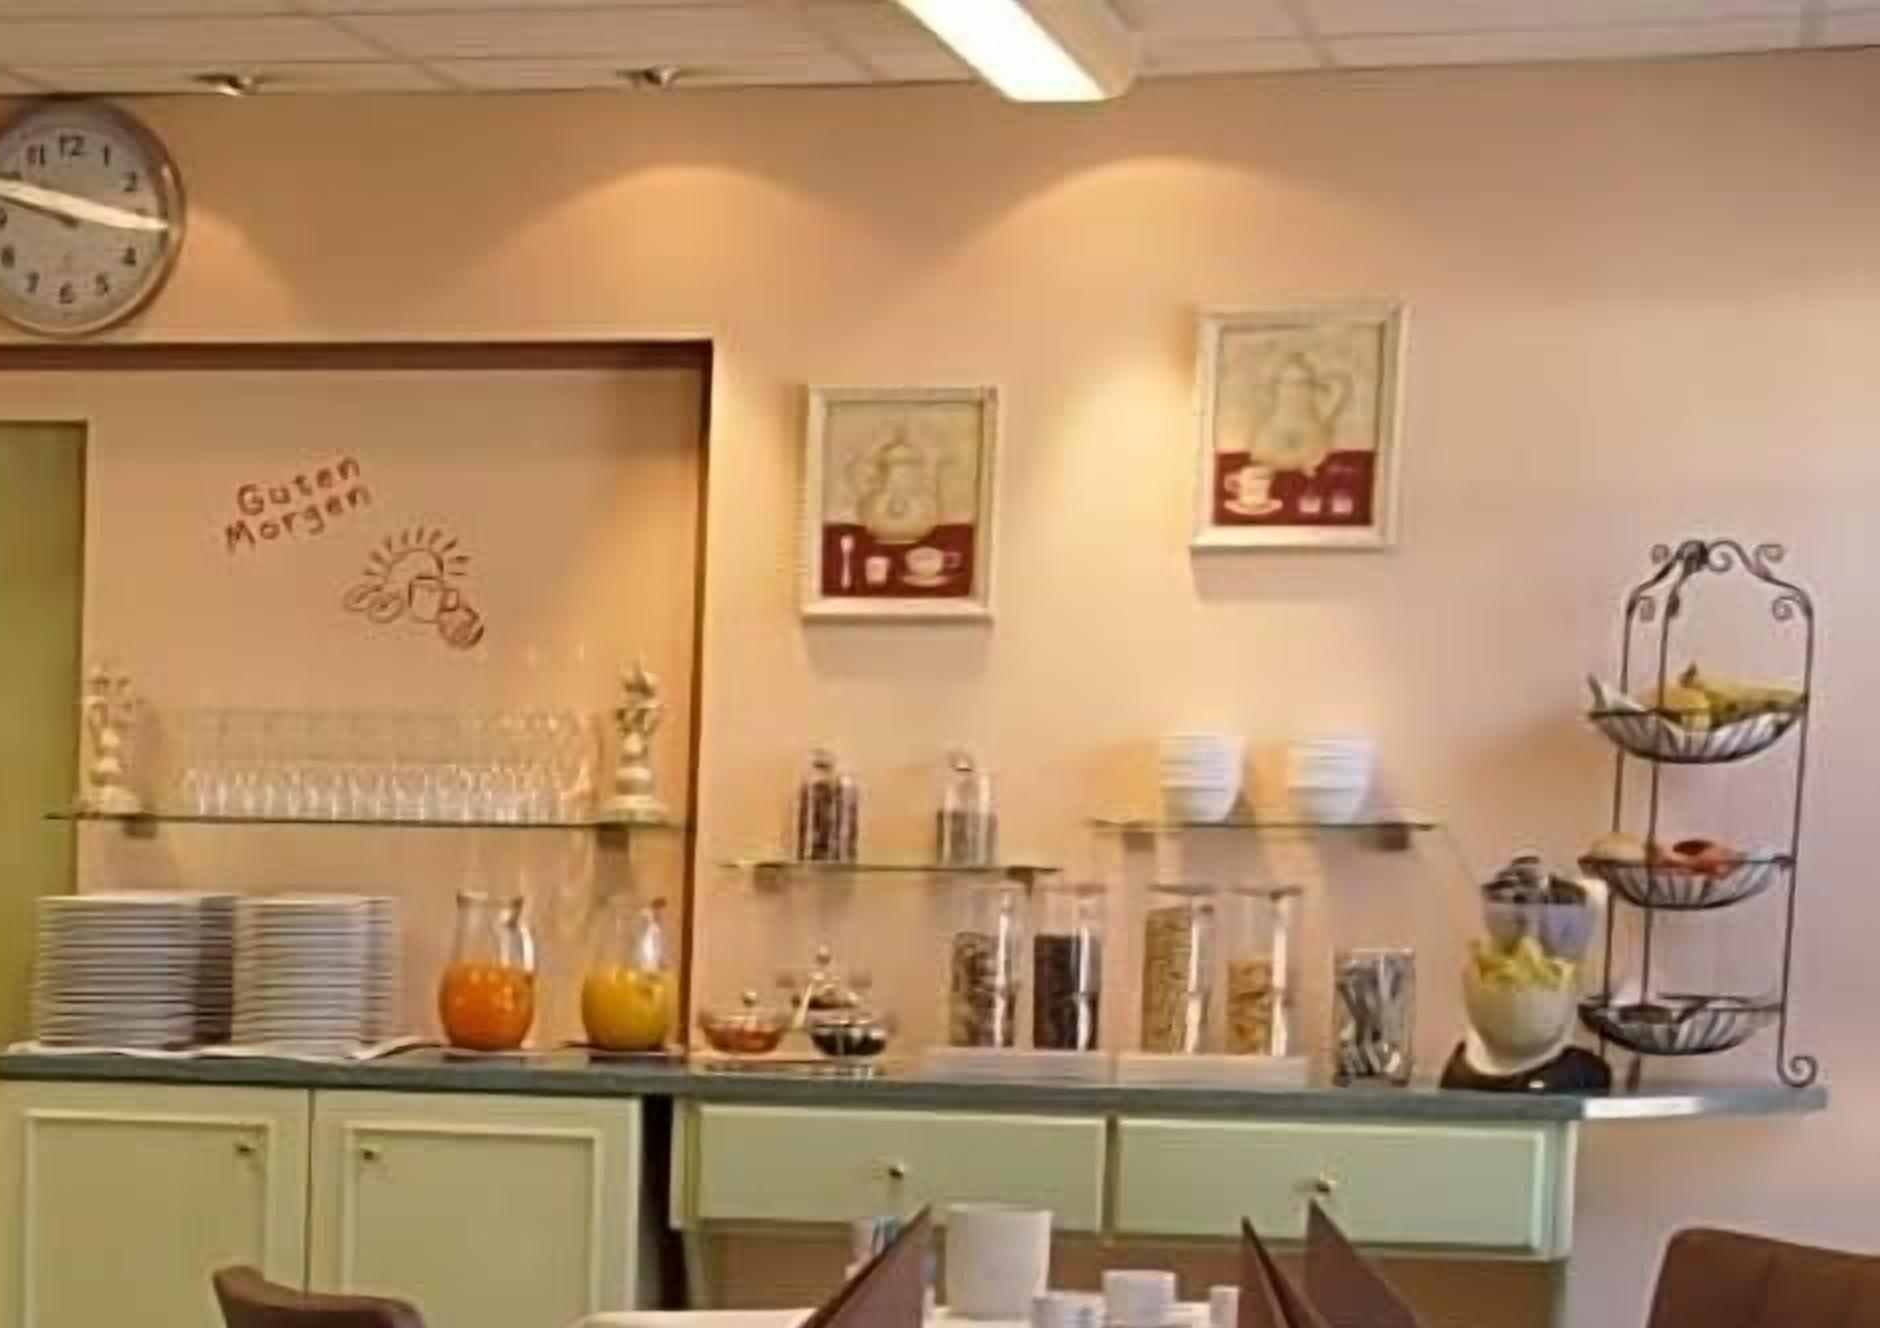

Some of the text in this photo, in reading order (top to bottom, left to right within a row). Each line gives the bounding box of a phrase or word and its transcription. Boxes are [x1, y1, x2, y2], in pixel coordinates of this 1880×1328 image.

[58, 135, 85, 158] 12
[123, 170, 138, 193] 2
[58, 281, 75, 305] 6
[236, 456, 361, 516] Guten
[225, 485, 371, 555] Morgen
